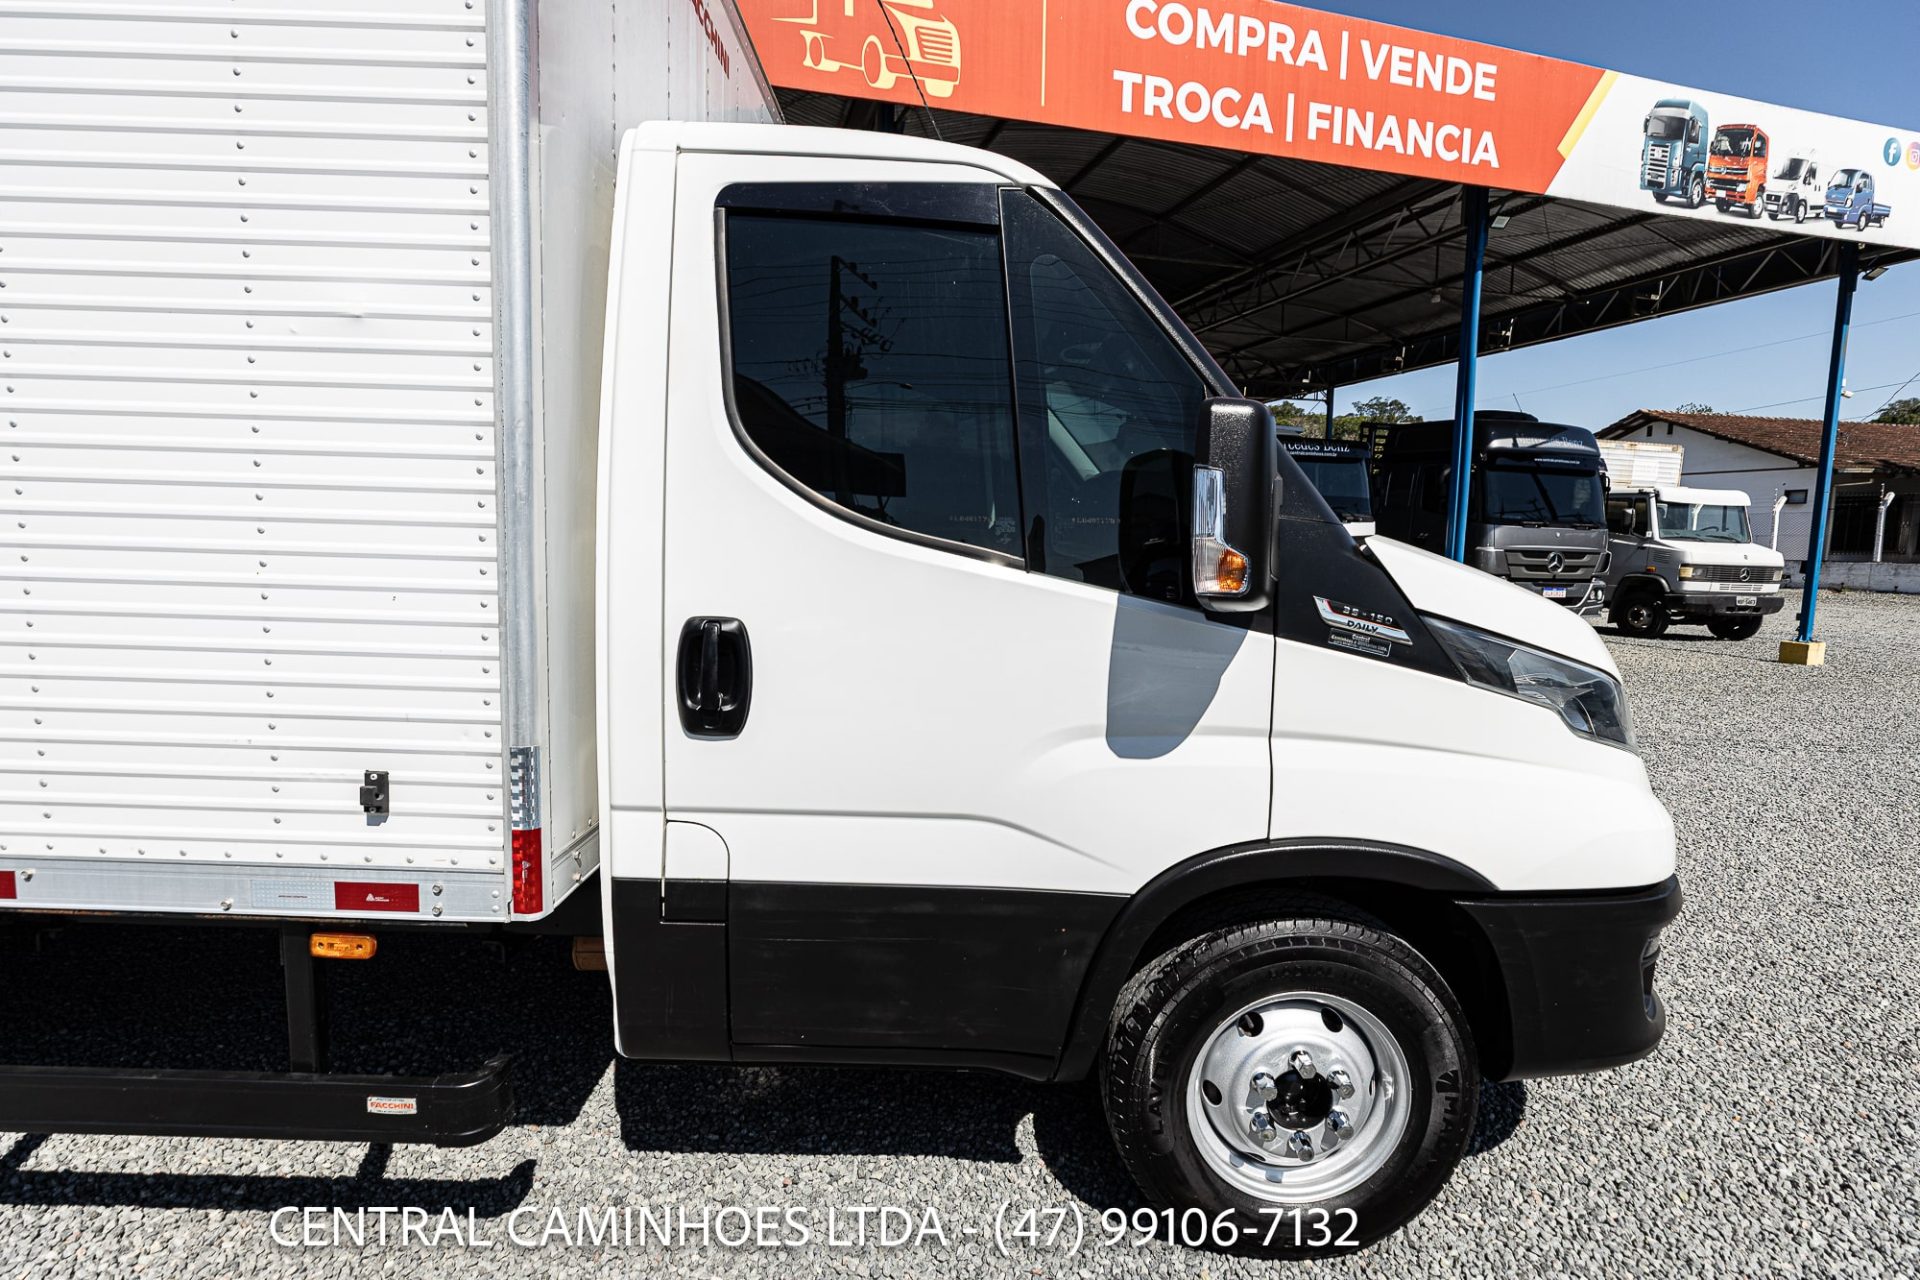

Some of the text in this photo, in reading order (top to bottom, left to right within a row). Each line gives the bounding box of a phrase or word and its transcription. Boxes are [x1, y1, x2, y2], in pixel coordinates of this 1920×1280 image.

[1125, 0, 1328, 72] COMPRA
[1360, 39, 1498, 101] VENDE
[1113, 69, 1273, 134] TROCA
[1307, 101, 1500, 169] FINANCIA
[1346, 620, 1379, 634] DAILY
[370, 1101, 414, 1110] FACCHINI
